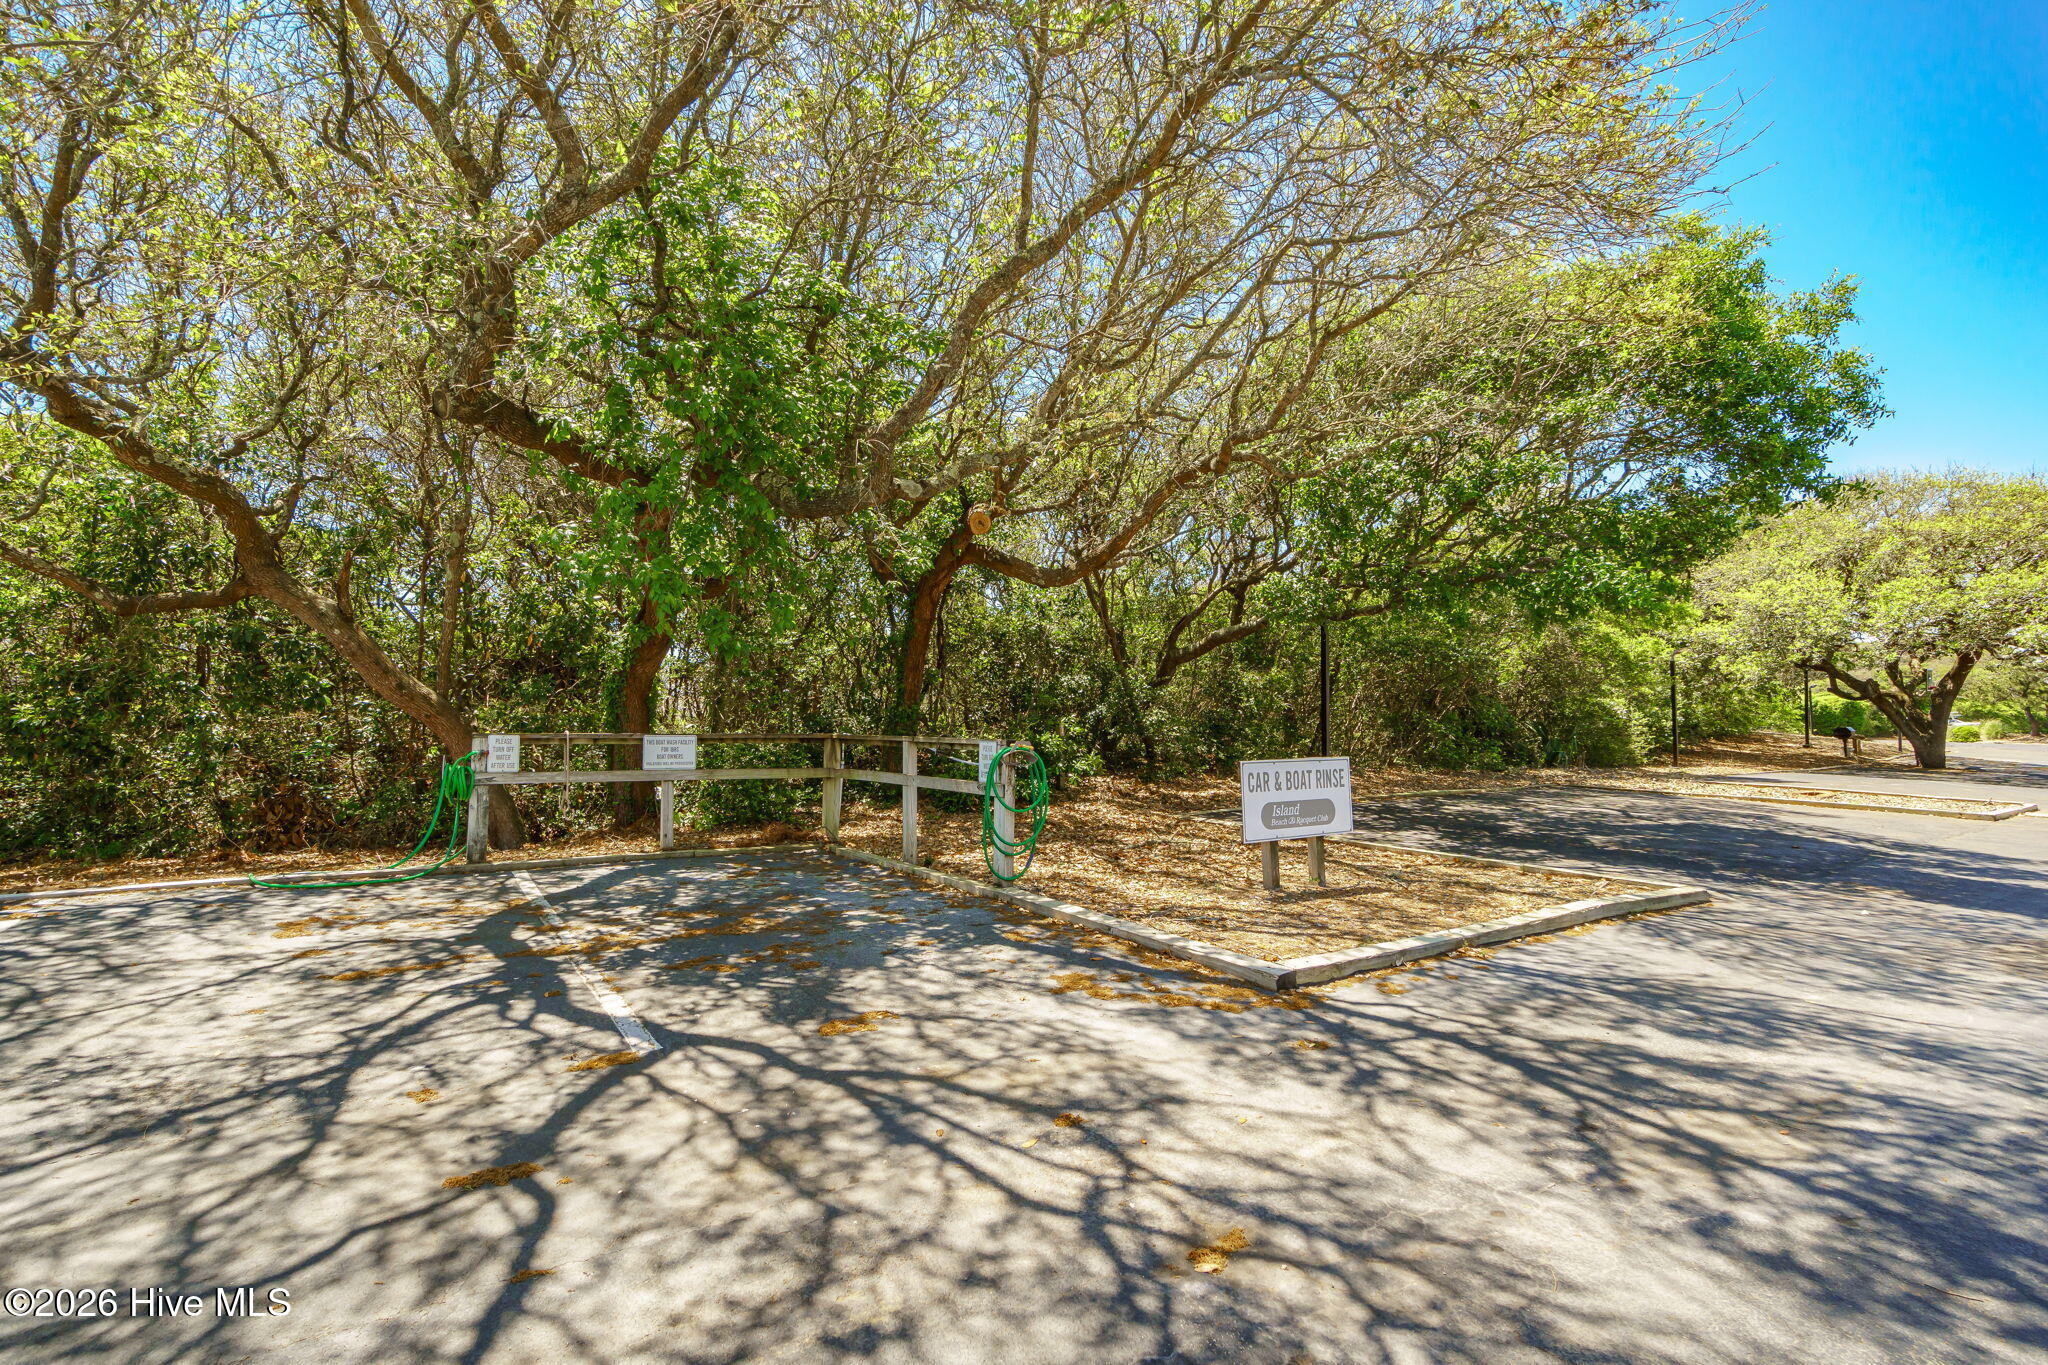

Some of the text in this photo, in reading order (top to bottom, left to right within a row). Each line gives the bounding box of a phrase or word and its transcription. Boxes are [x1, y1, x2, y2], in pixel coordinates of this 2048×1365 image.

[1248, 768, 1345, 793] CAR & BOAT RINSE
[1272, 804, 1300, 816] Island
[1296, 816, 1316, 825] Racquet
